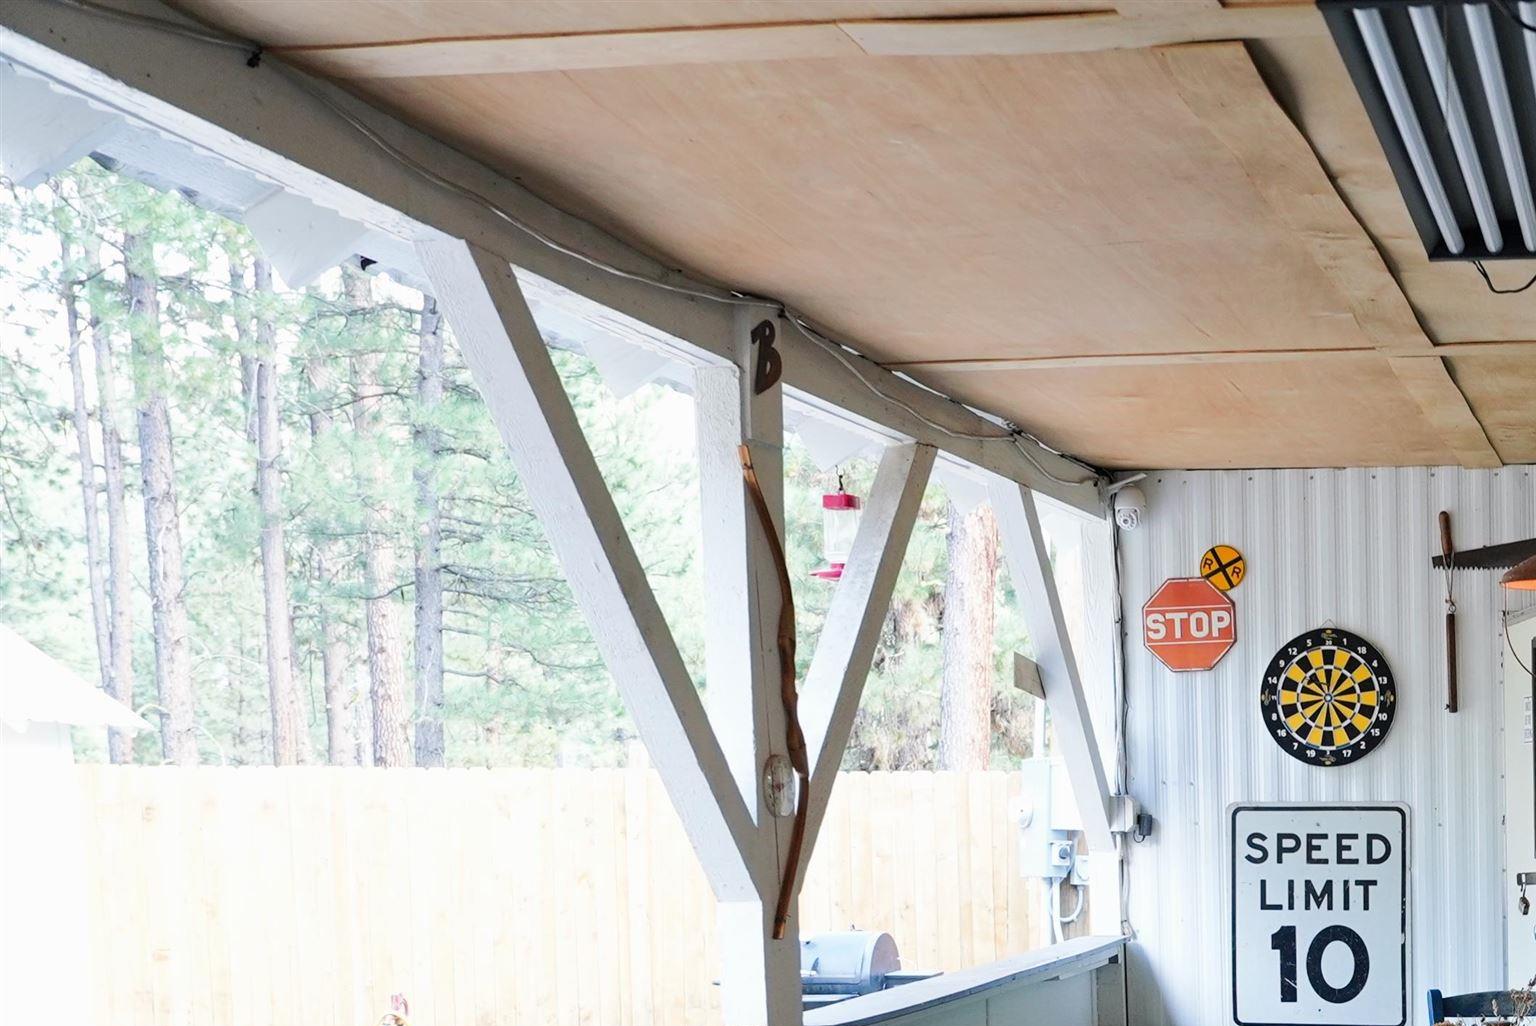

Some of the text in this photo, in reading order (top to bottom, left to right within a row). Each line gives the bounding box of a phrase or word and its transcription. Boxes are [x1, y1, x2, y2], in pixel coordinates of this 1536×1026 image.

[750, 320, 782, 395] B
[1203, 558, 1242, 579] R R
[1146, 610, 1231, 640] STOP
[1306, 639, 1312, 647] 5
[1342, 638, 1347, 646] 1
[1288, 647, 1298, 656] 12
[1357, 646, 1367, 655] 18
[1279, 659, 1285, 668] 9
[1372, 659, 1378, 668] 4
[1267, 676, 1278, 684] 14
[1378, 676, 1388, 685] 13
[1271, 712, 1278, 721] 8
[1378, 712, 1388, 721] 10
[1276, 728, 1287, 738] 16
[1370, 728, 1380, 737] 15
[1292, 742, 1299, 750] 7
[1360, 741, 1366, 750] 2
[1306, 749, 1316, 758] 19
[1342, 749, 1352, 758] 17
[1244, 832, 1392, 865] SPEED
[1260, 879, 1378, 911] LIMIT
[1271, 924, 1371, 1004] 10
